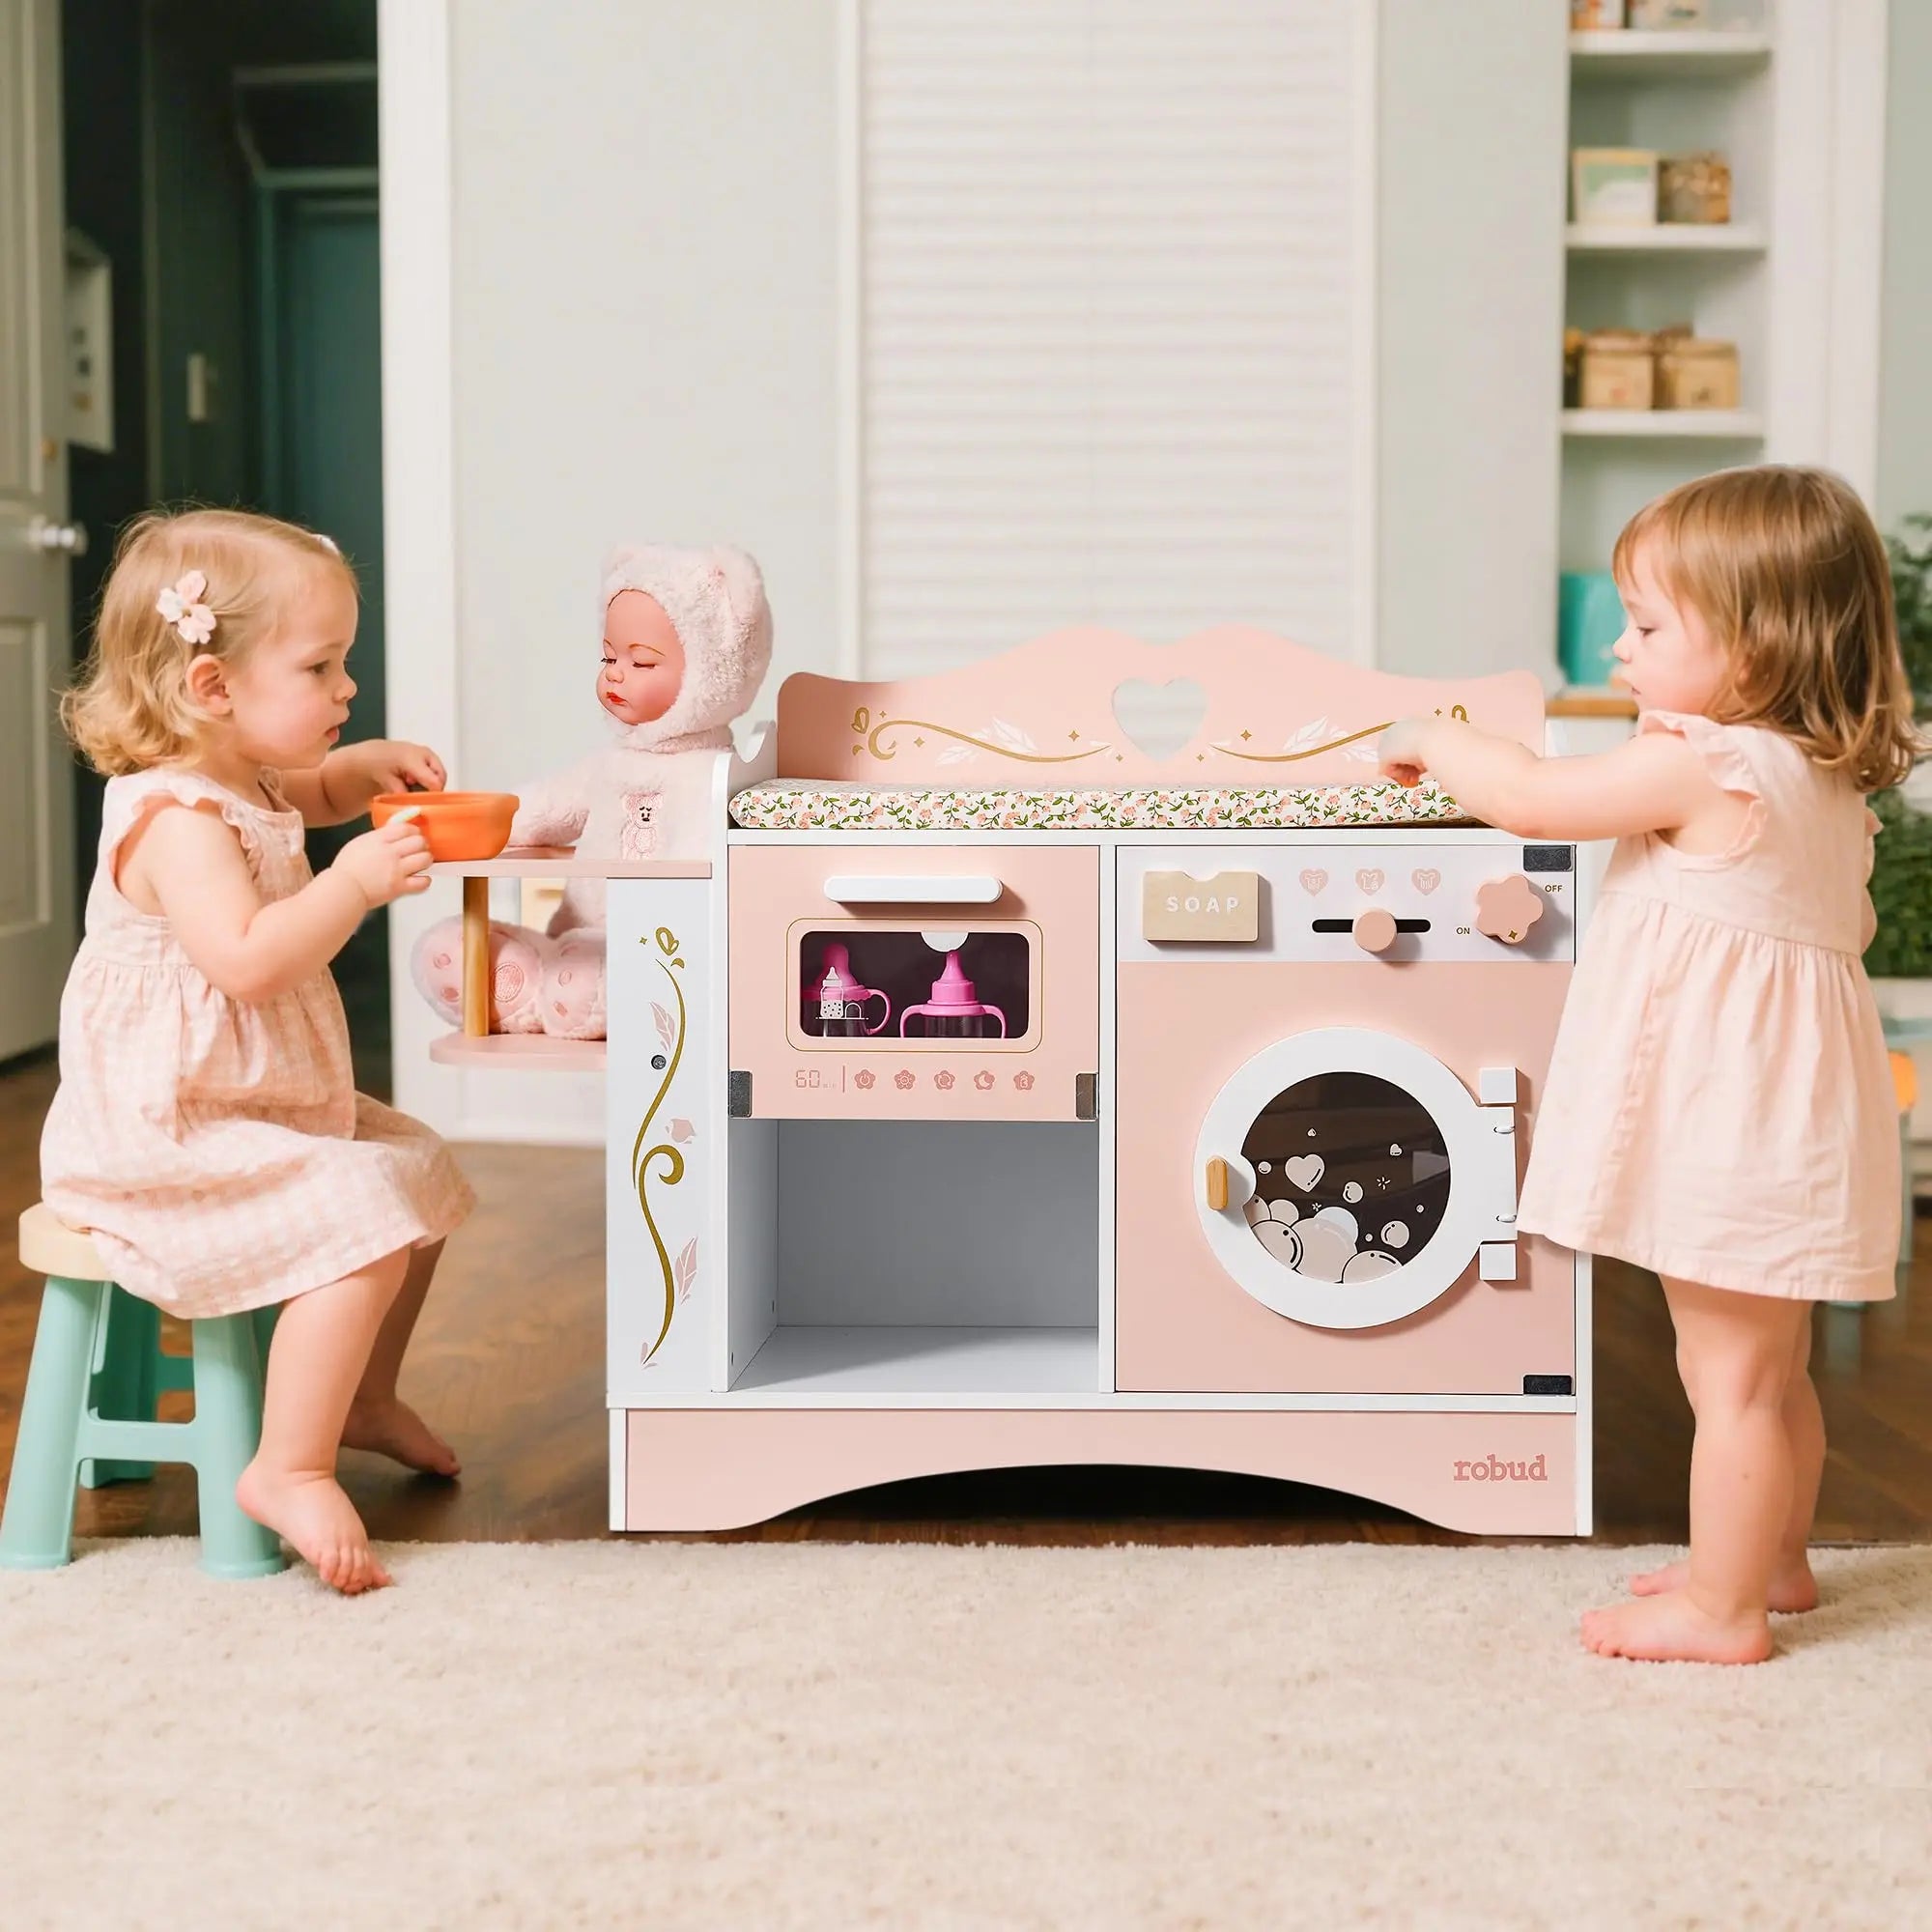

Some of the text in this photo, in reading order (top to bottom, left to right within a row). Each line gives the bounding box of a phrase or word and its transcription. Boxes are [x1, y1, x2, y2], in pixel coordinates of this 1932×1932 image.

[1545, 884, 1563, 893] OFF
[1166, 895, 1239, 913] SOAP
[1456, 926, 1470, 935] ON
[796, 1069, 820, 1088] 60
[1453, 1453, 1548, 1482] robud
